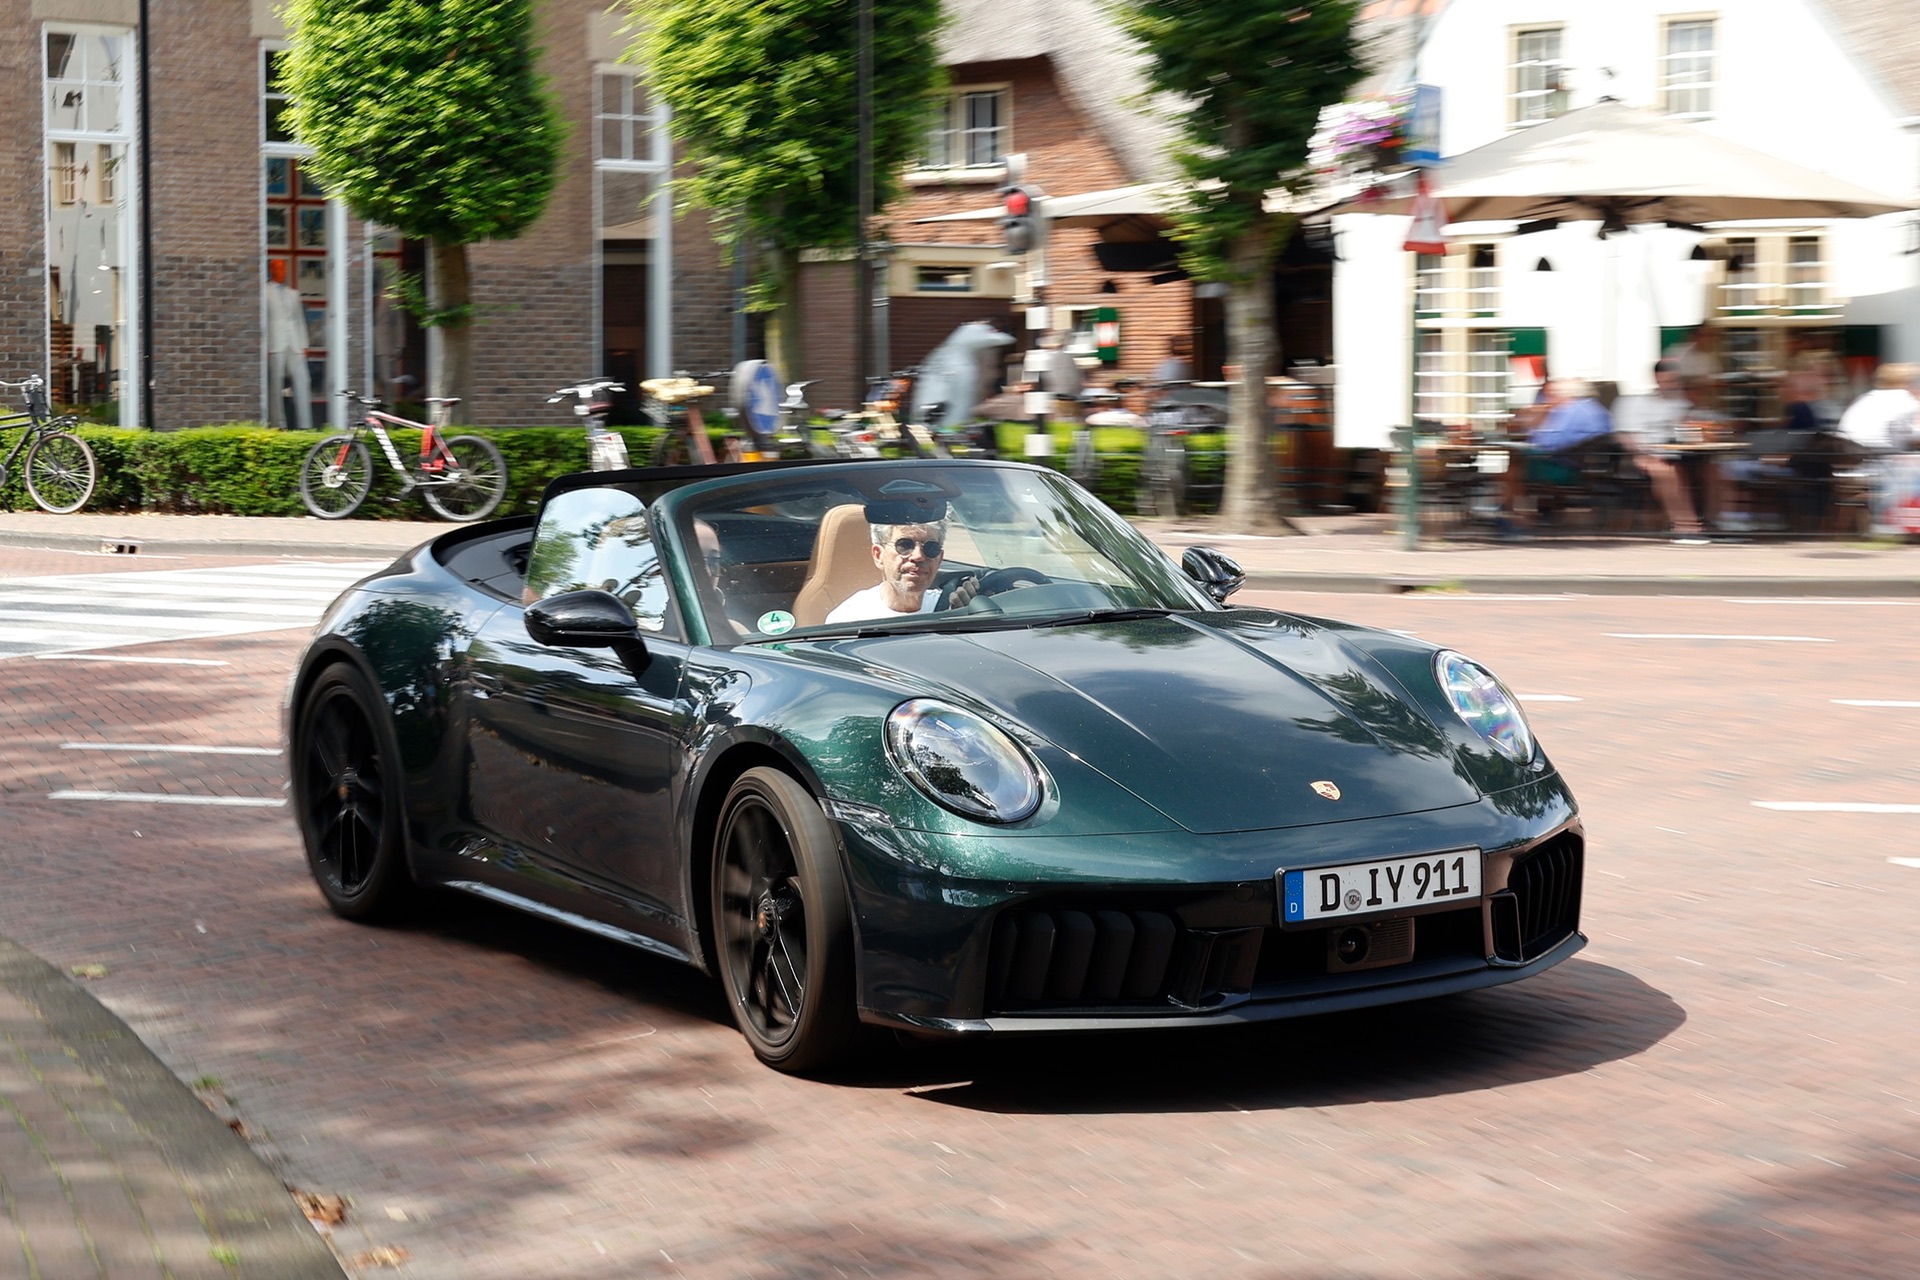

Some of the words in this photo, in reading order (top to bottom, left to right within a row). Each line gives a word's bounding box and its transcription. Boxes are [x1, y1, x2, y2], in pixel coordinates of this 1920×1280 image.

[771, 613, 781, 622] 4
[1320, 873, 1341, 912] D
[1366, 865, 1404, 906] IY
[1413, 857, 1469, 900] 911
[1290, 902, 1298, 914] D
